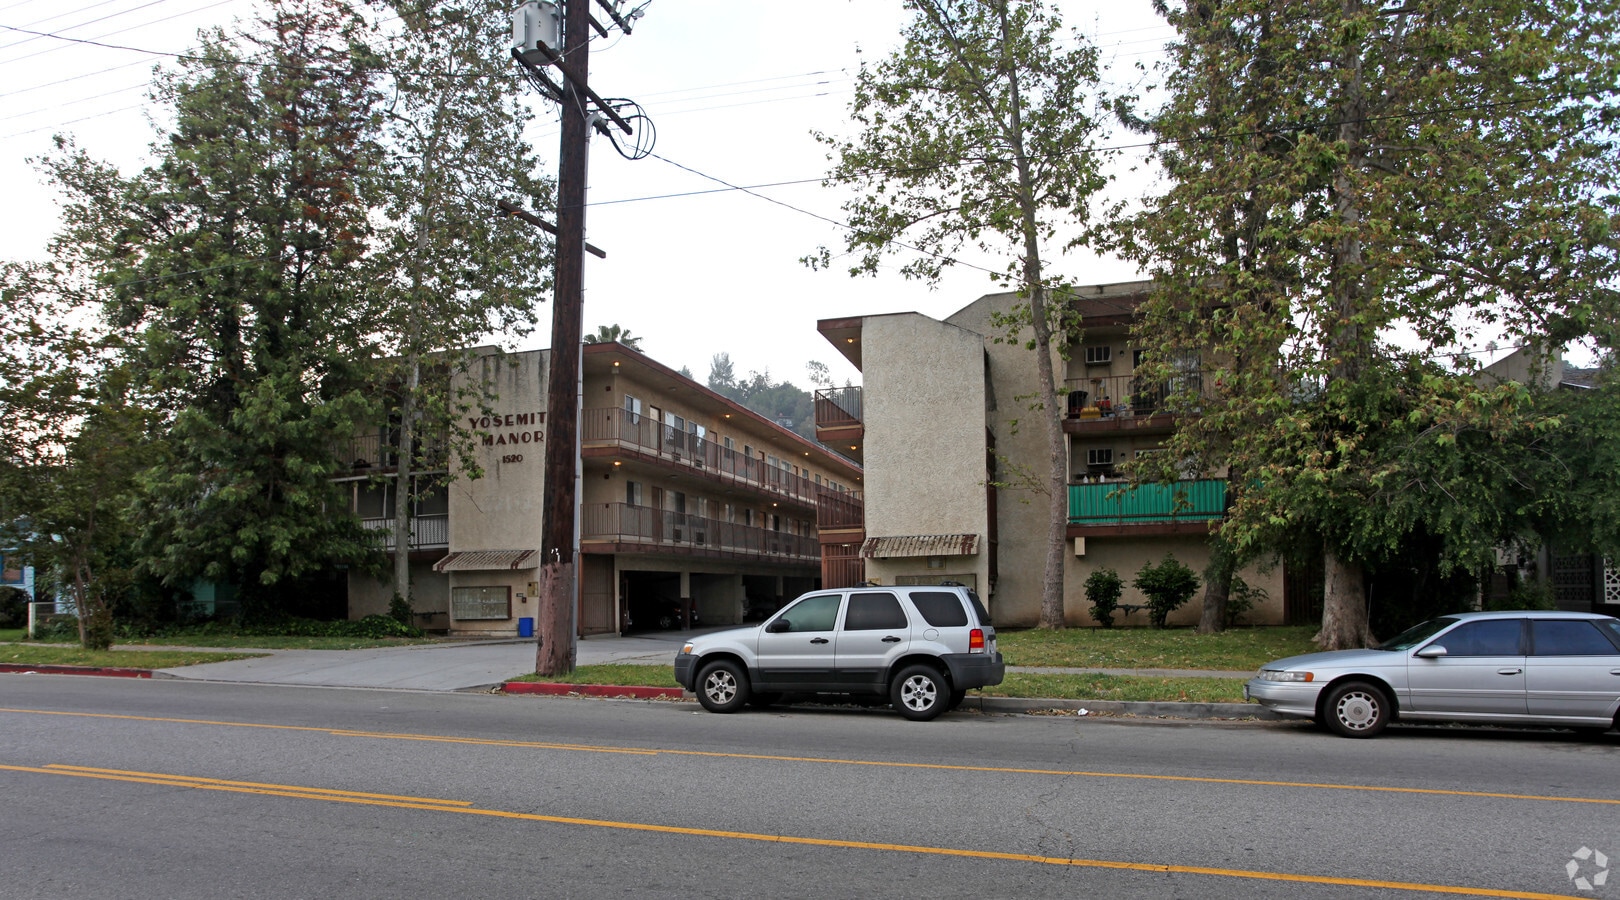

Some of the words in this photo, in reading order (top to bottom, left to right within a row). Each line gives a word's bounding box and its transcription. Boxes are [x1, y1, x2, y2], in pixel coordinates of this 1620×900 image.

[468, 411, 547, 429] YOSEMIT
[482, 430, 544, 446] MANOR
[502, 454, 523, 464] 1520
